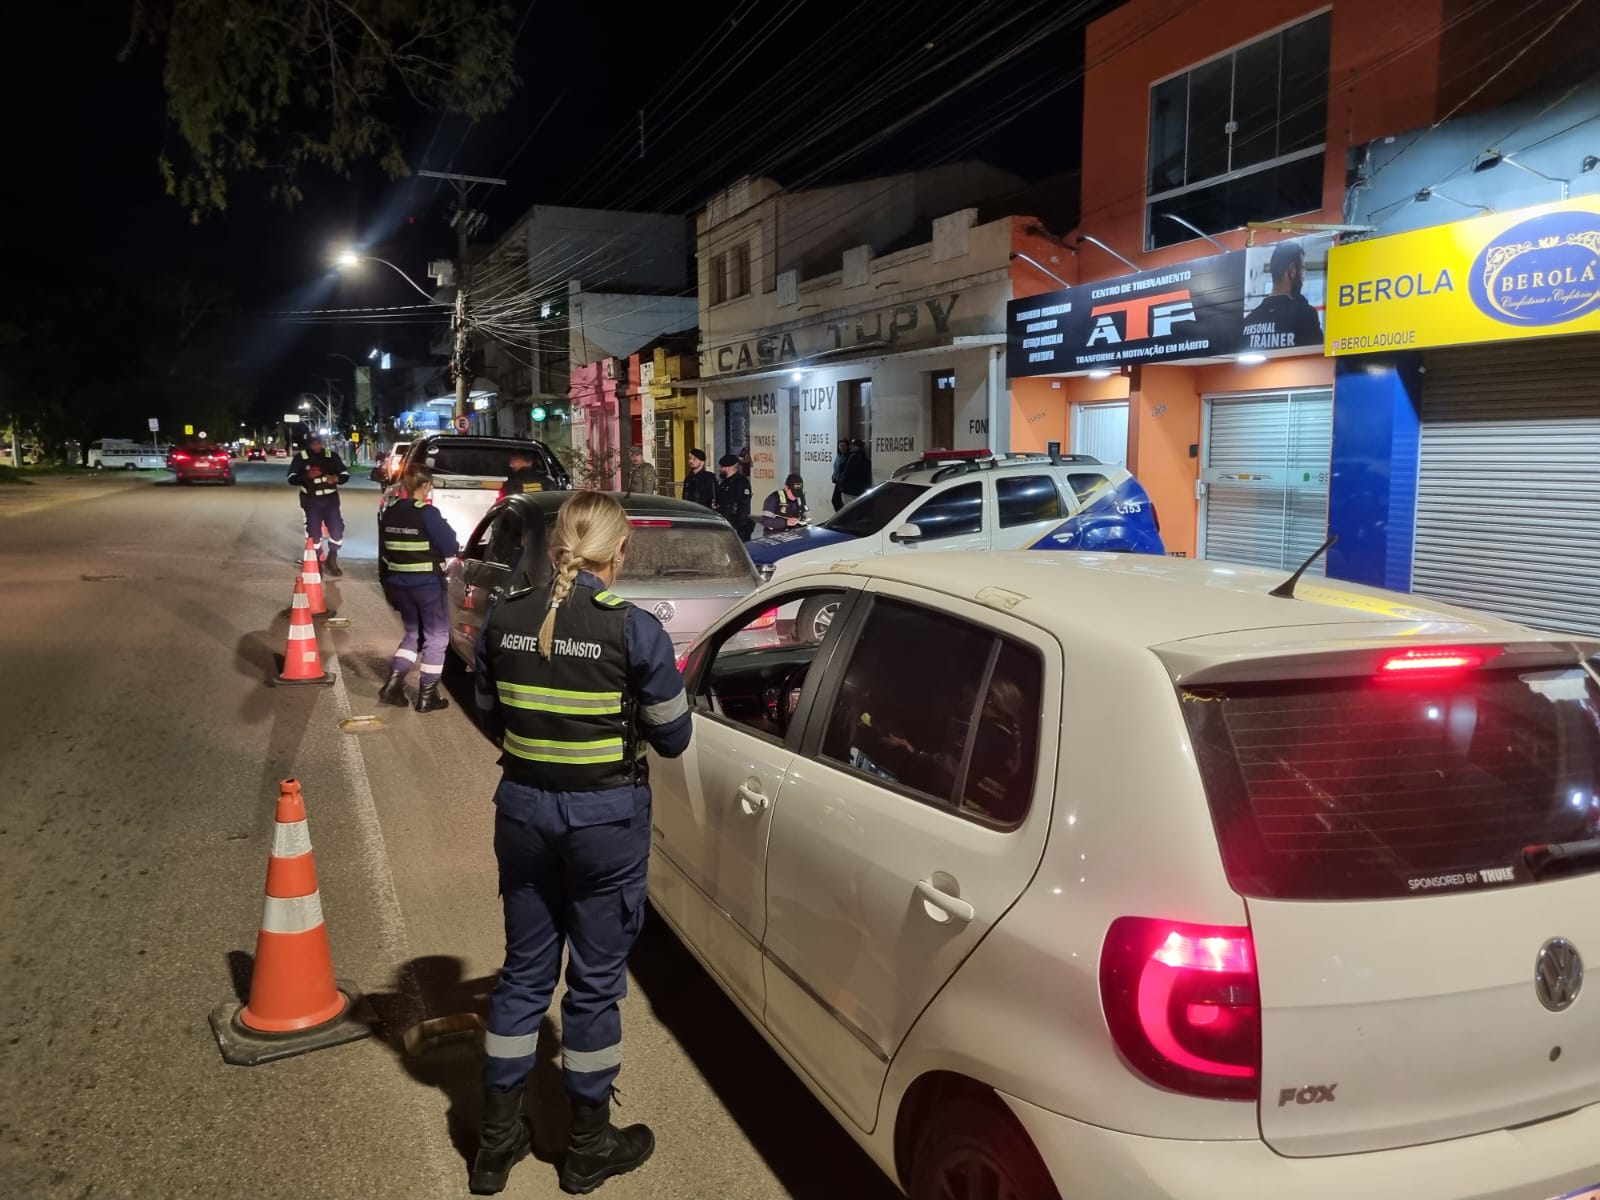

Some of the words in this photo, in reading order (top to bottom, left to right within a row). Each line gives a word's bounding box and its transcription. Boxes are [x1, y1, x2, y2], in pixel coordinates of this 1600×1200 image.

[1091, 287, 1120, 299] CENTRO
[1121, 283, 1131, 293] DE
[1132, 271, 1191, 291] TREINAMENTO
[1339, 269, 1454, 308] BEROLA
[1502, 265, 1595, 292] BEROLA
[1086, 289, 1196, 347] ATF
[1243, 322, 1276, 335] PERSONAL
[718, 333, 798, 372] CASA
[826, 294, 959, 349] TUPY
[1250, 332, 1295, 348] TRAINER
[1341, 331, 1415, 350] BEROLADUQUE
[1115, 351, 1121, 359] A
[1122, 344, 1165, 357] MOTIVAÇÃO
[1166, 344, 1177, 353] EM
[750, 392, 777, 415] CASA
[801, 386, 834, 411] TUPY
[771, 434, 776, 446] E
[804, 433, 823, 445] TUBOS
[825, 433, 829, 445] E
[876, 436, 914, 453] FERRAGEM
[804, 448, 833, 463] CONEXÕES
[500, 633, 538, 652] AGENTE
[554, 638, 602, 659] TRÂNSITO
[1408, 874, 1465, 890] SPONSORED
[1465, 872, 1478, 884] BY
[1479, 865, 1515, 883] THULE
[1278, 1083, 1338, 1107] FOX
